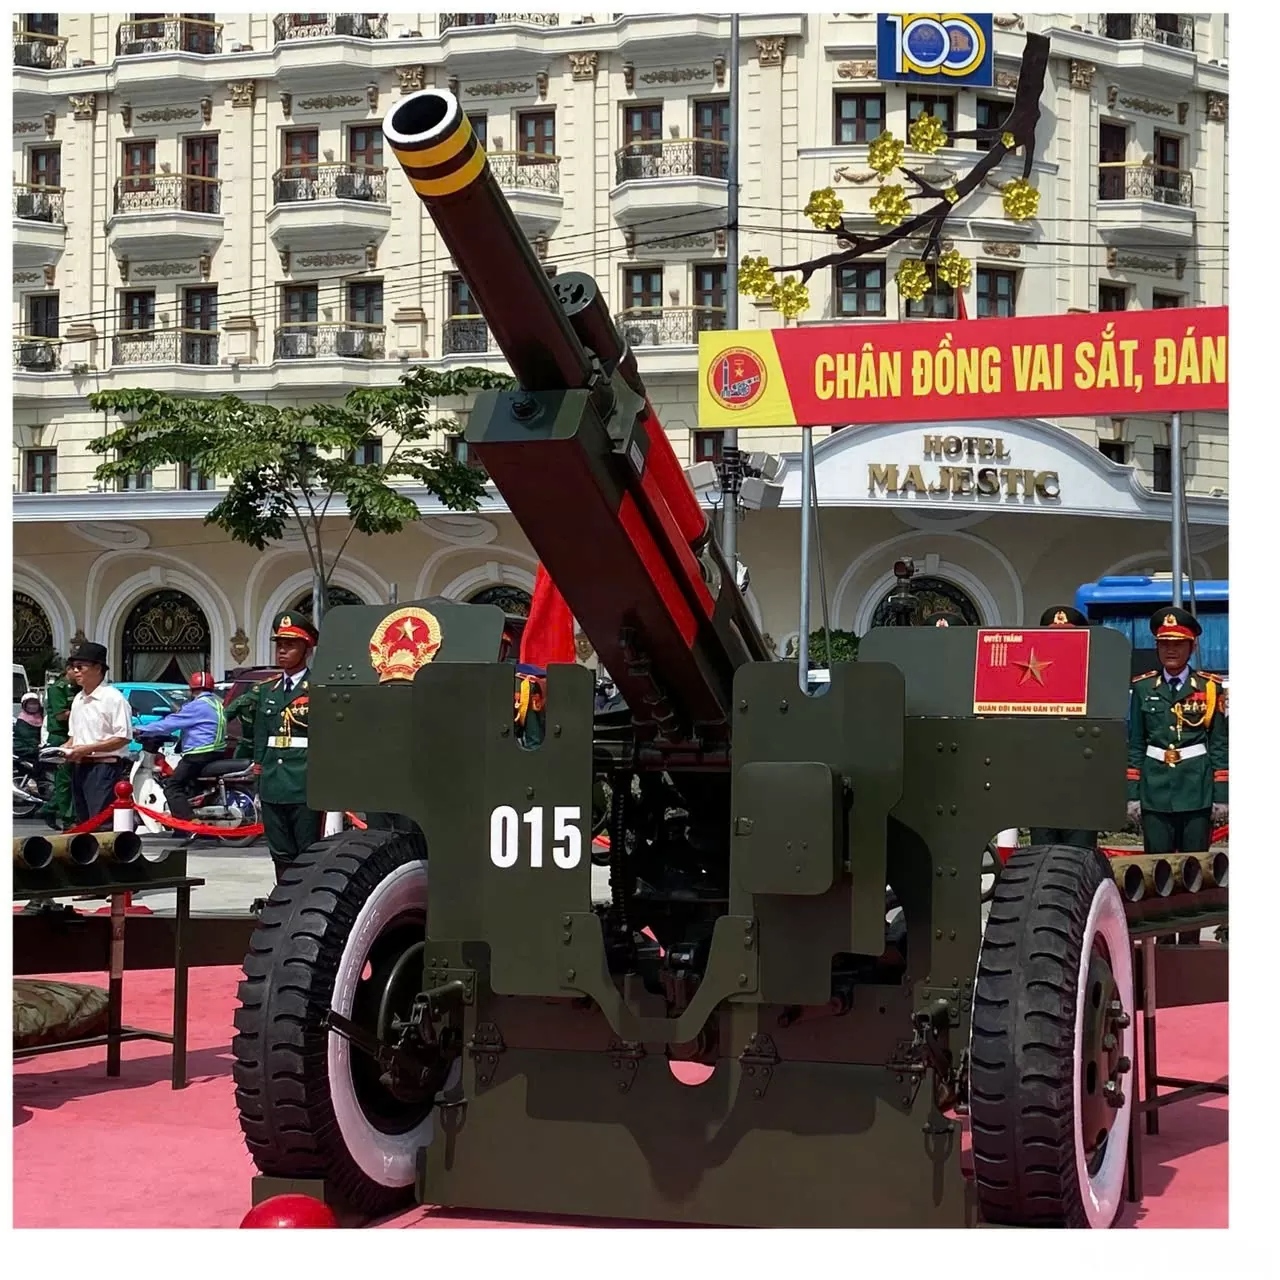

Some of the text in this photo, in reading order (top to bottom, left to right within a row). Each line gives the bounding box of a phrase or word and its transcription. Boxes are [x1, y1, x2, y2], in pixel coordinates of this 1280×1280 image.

[886, 13, 986, 76] 100
[814, 343, 902, 400] CHÂN
[912, 332, 1002, 397] ĐỒNG
[1011, 343, 1063, 393] VAI
[1074, 322, 1143, 394] SẮT,
[1153, 326, 1227, 386] ĐÁN
[923, 434, 1011, 460] HOTEL
[867, 463, 1061, 499] MAJESTIC
[490, 805, 582, 869] 015
